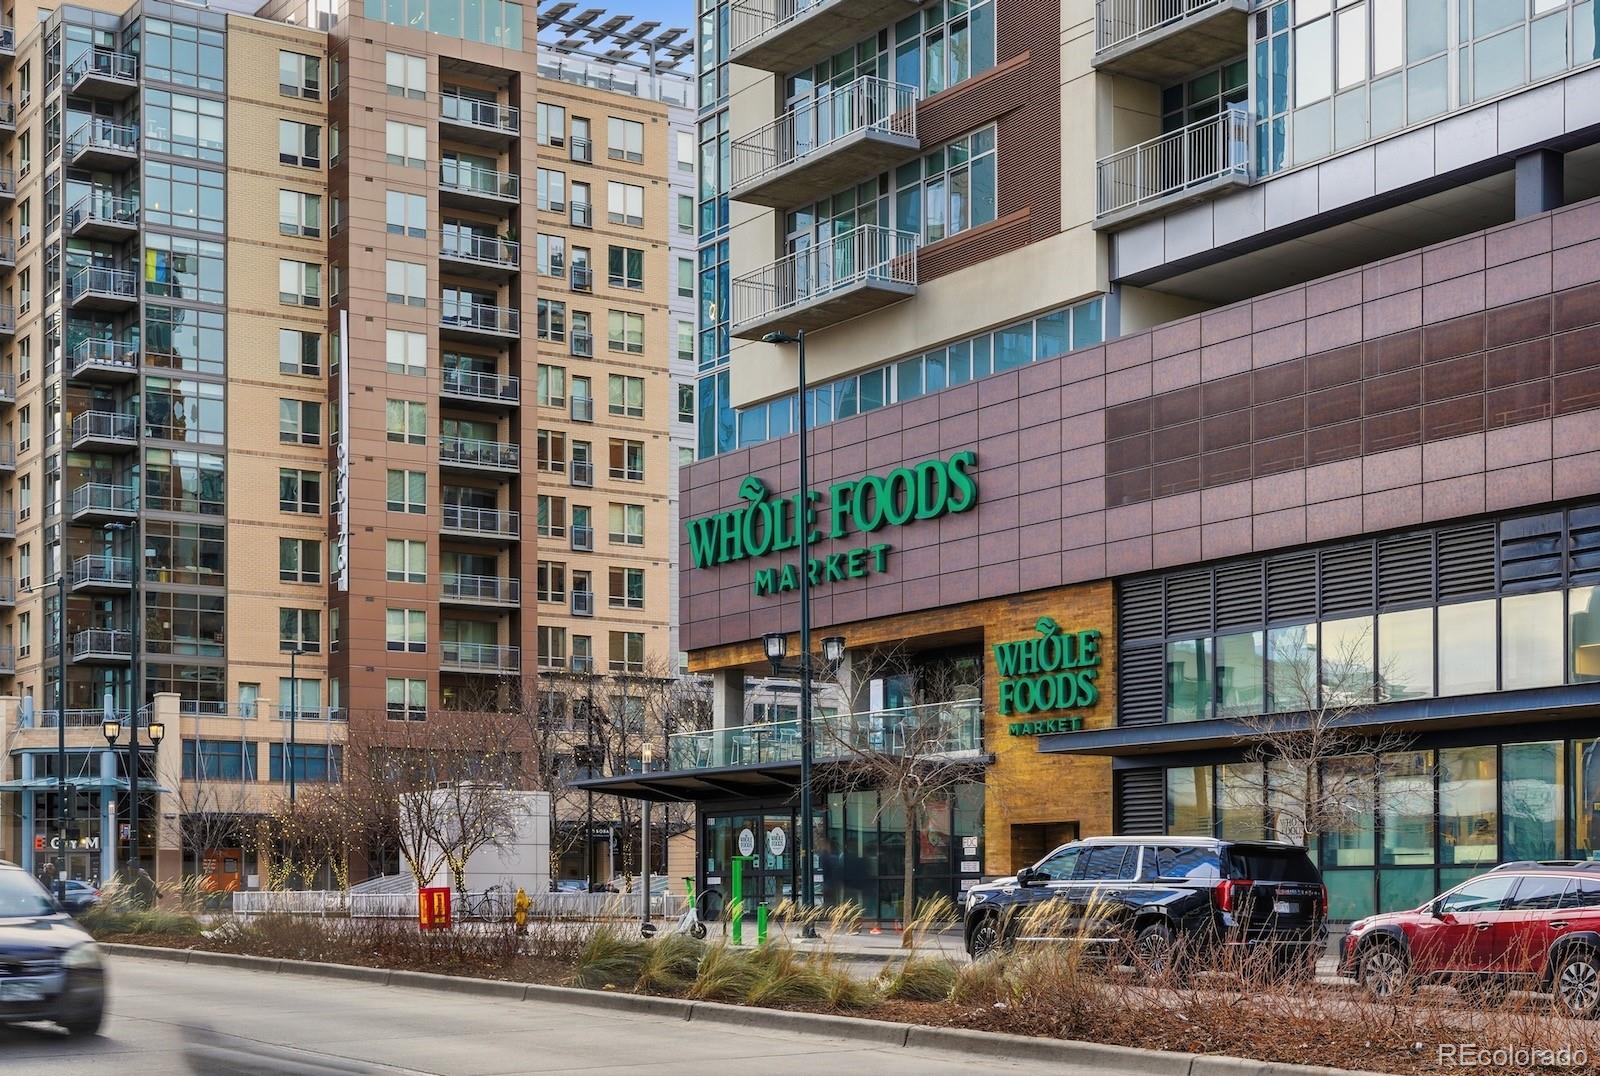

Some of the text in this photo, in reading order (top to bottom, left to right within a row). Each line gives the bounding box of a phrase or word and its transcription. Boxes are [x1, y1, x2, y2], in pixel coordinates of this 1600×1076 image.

[685, 451, 977, 568] WHOLE FOODS
[755, 544, 892, 596] MARKET
[992, 616, 1102, 677] WHOLE
[998, 669, 1098, 716] FOODS
[1008, 716, 1082, 736] MARKET
